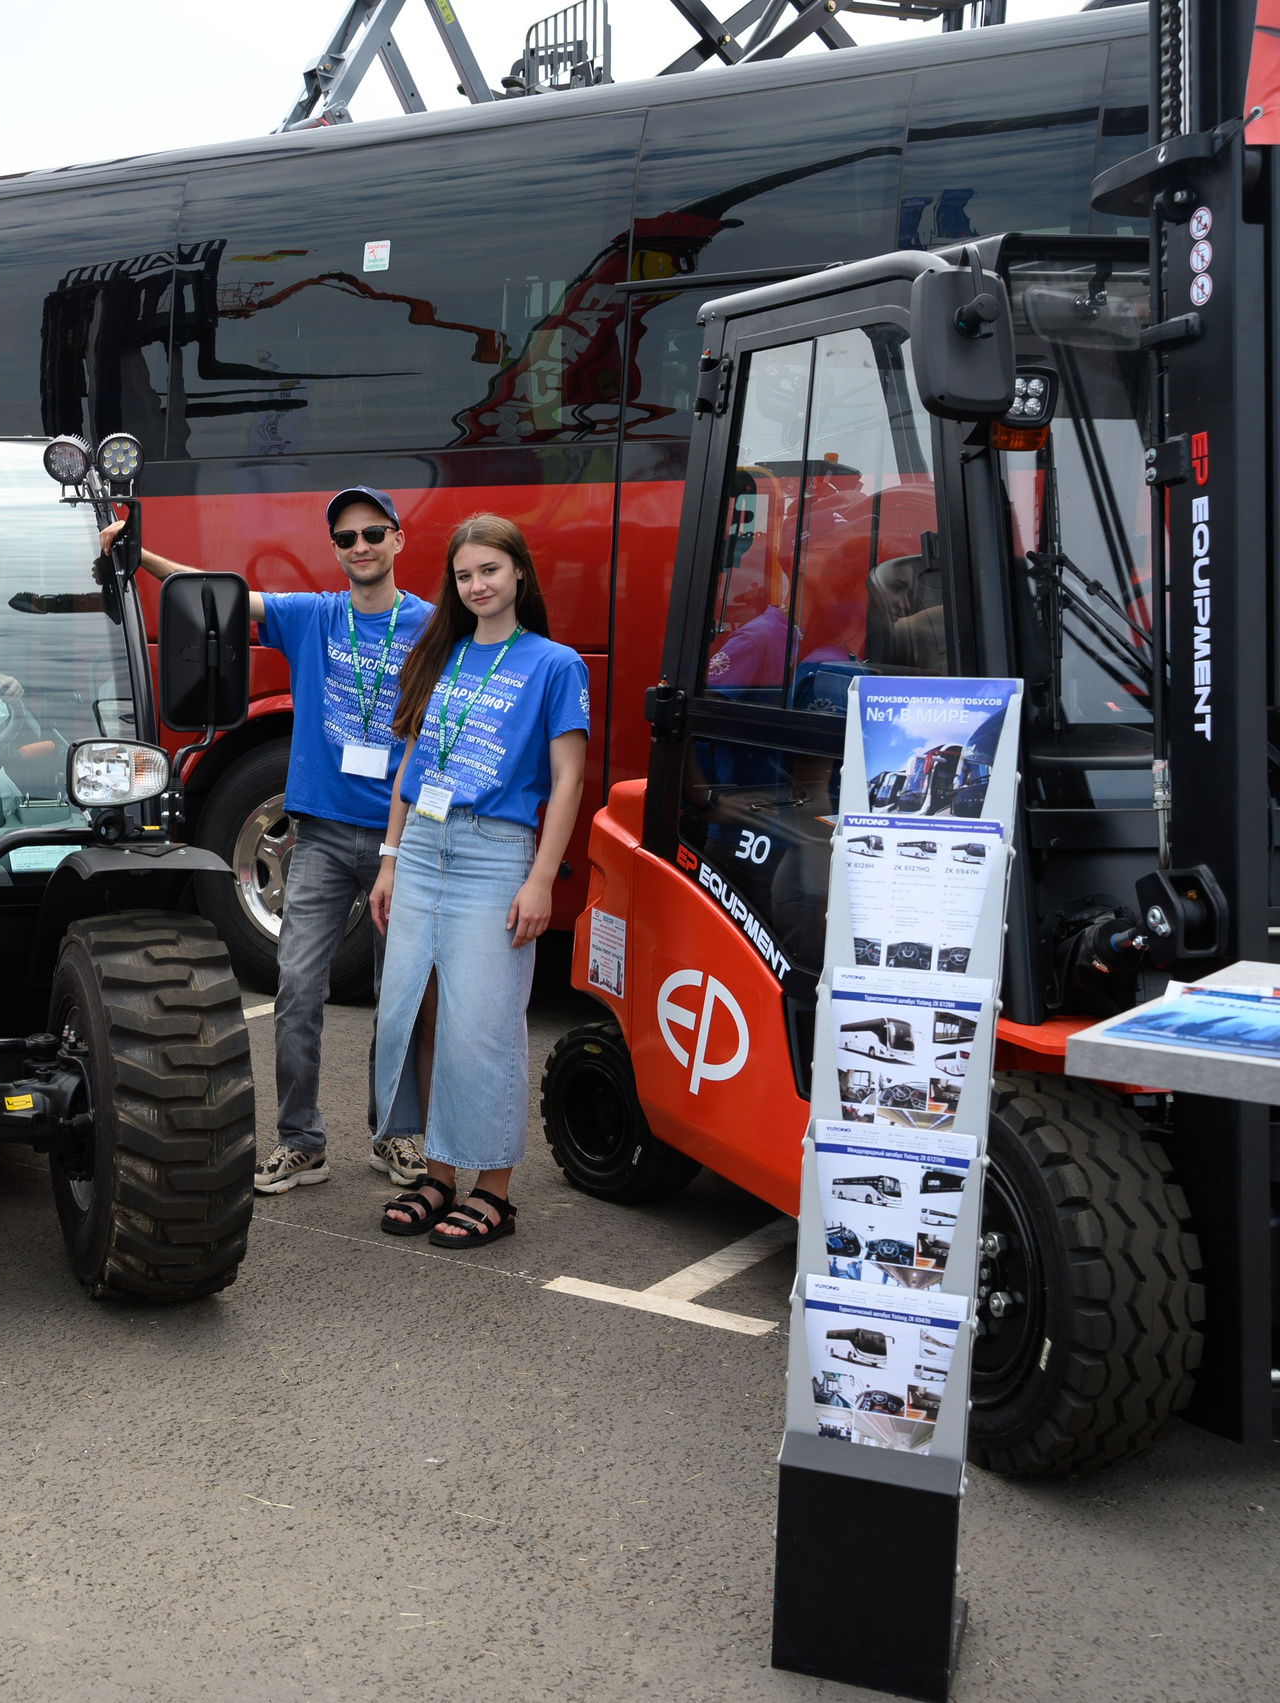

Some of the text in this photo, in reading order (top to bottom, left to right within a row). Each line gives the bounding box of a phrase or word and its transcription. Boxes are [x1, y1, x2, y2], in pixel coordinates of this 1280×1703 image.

[1191, 431, 1212, 742] EP EQUIPMENT
[379, 639, 413, 652] АОБУСЫ
[328, 646, 402, 676] БЕЛАУСЛИФ
[490, 673, 524, 688] АВТОБУСЫ
[501, 669, 529, 682] КРЕАТИВ
[433, 682, 514, 713] БЕАРУЛИФТ
[867, 695, 1002, 706] ПРОИЗВОДИТЕЛЬ АВТОБУСОВ
[866, 708, 970, 724] №1 В МИРЕ
[465, 718, 497, 734] РИЧТРАКИ
[467, 735, 506, 755] ПОГРУЗЧИКИ
[419, 744, 440, 756] КРЕАТ
[447, 753, 498, 777] ЭЛЕКТРОТЕЛЕЖКИ
[482, 748, 502, 761] ИДЕИ
[474, 777, 492, 790] РОСТ
[847, 817, 890, 826] YUTONG
[735, 830, 771, 864] 30
[955, 868, 979, 876] 6947H
[677, 844, 791, 980] EP EQUIPMENT
[864, 994, 897, 1003] Туристический
[847, 1147, 884, 1156] Междугородный
[839, 1306, 872, 1315] Туристический
[872, 1310, 890, 1319] автобус
